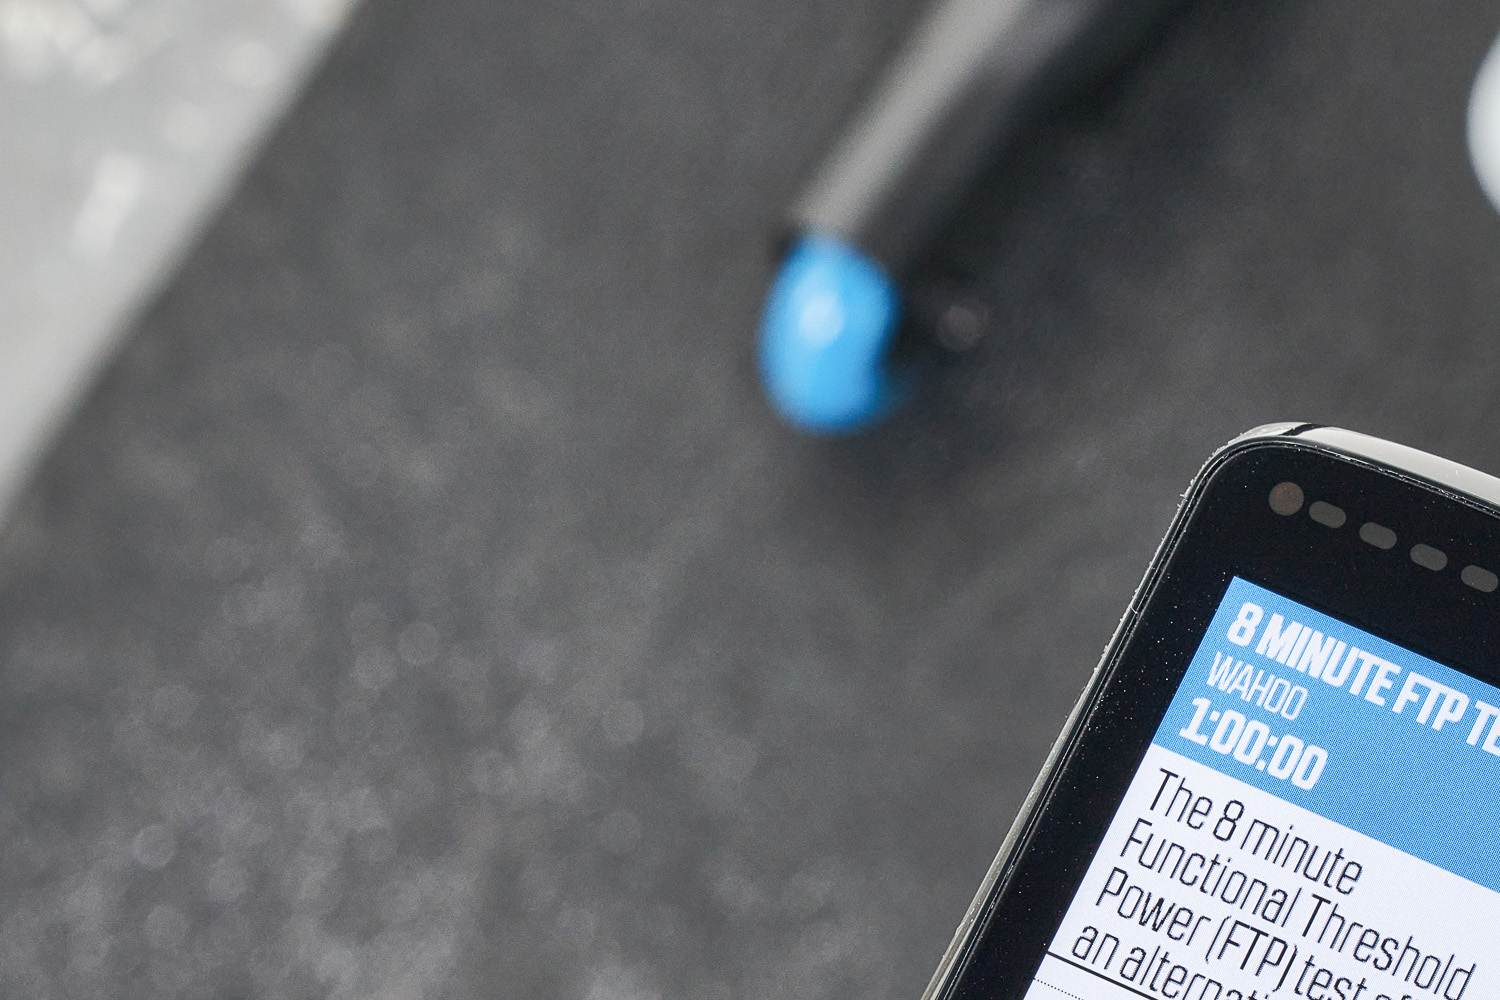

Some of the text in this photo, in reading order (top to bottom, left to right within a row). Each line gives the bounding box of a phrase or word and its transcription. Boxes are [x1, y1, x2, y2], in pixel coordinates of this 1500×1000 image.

[1206, 652, 1308, 721] WAHOO
[1226, 602, 1264, 647] 8
[1256, 614, 1402, 707] MINUTE
[1392, 671, 1470, 731] FTP
[1179, 697, 1329, 791] 1:00:00
[1119, 818, 1304, 929] Functional
[1148, 768, 1363, 896] The 8 minute
[1071, 924, 1119, 971] an
[1095, 866, 1212, 947] Power
[1204, 915, 1299, 992] (FTP)
